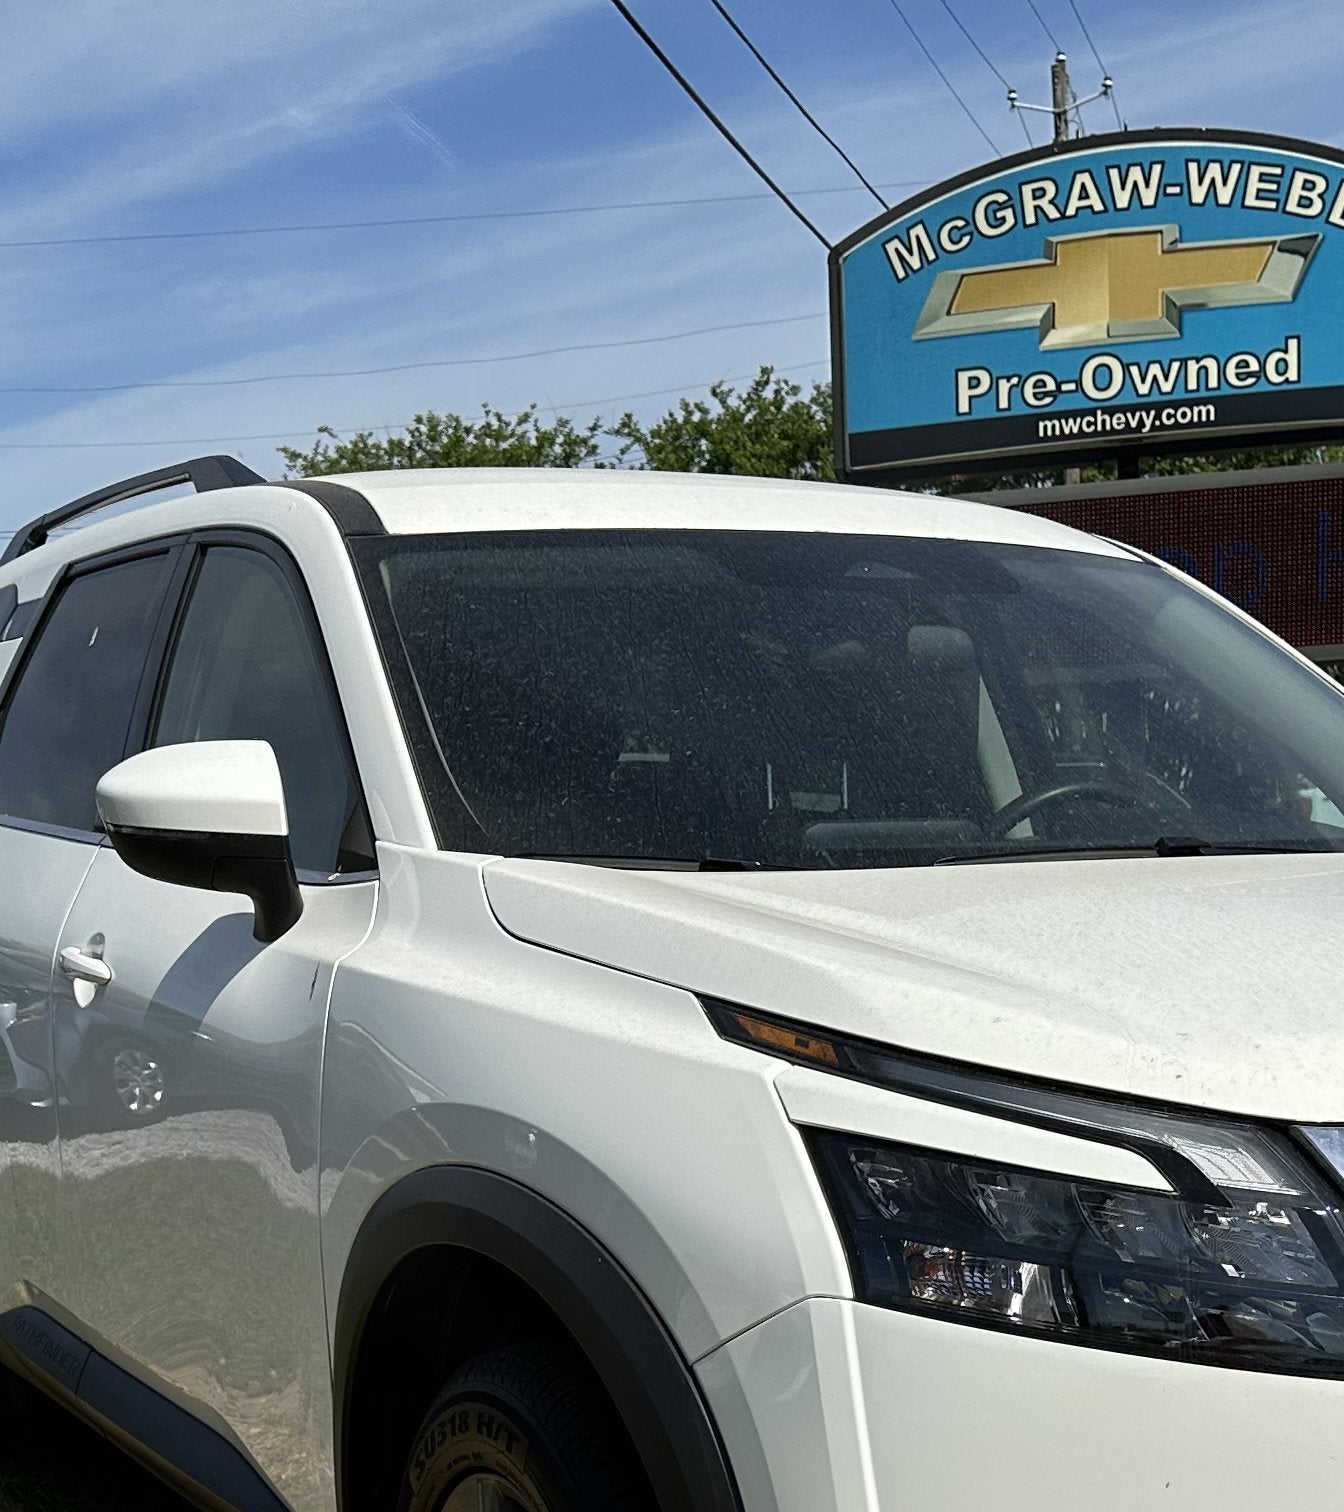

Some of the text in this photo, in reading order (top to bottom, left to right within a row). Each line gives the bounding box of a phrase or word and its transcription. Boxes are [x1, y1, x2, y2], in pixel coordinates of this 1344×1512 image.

[956, 337, 1301, 414] Pre-Owned
[1037, 401, 1216, 438] mwchevy.com
[478, 1411, 517, 1454] H/T
